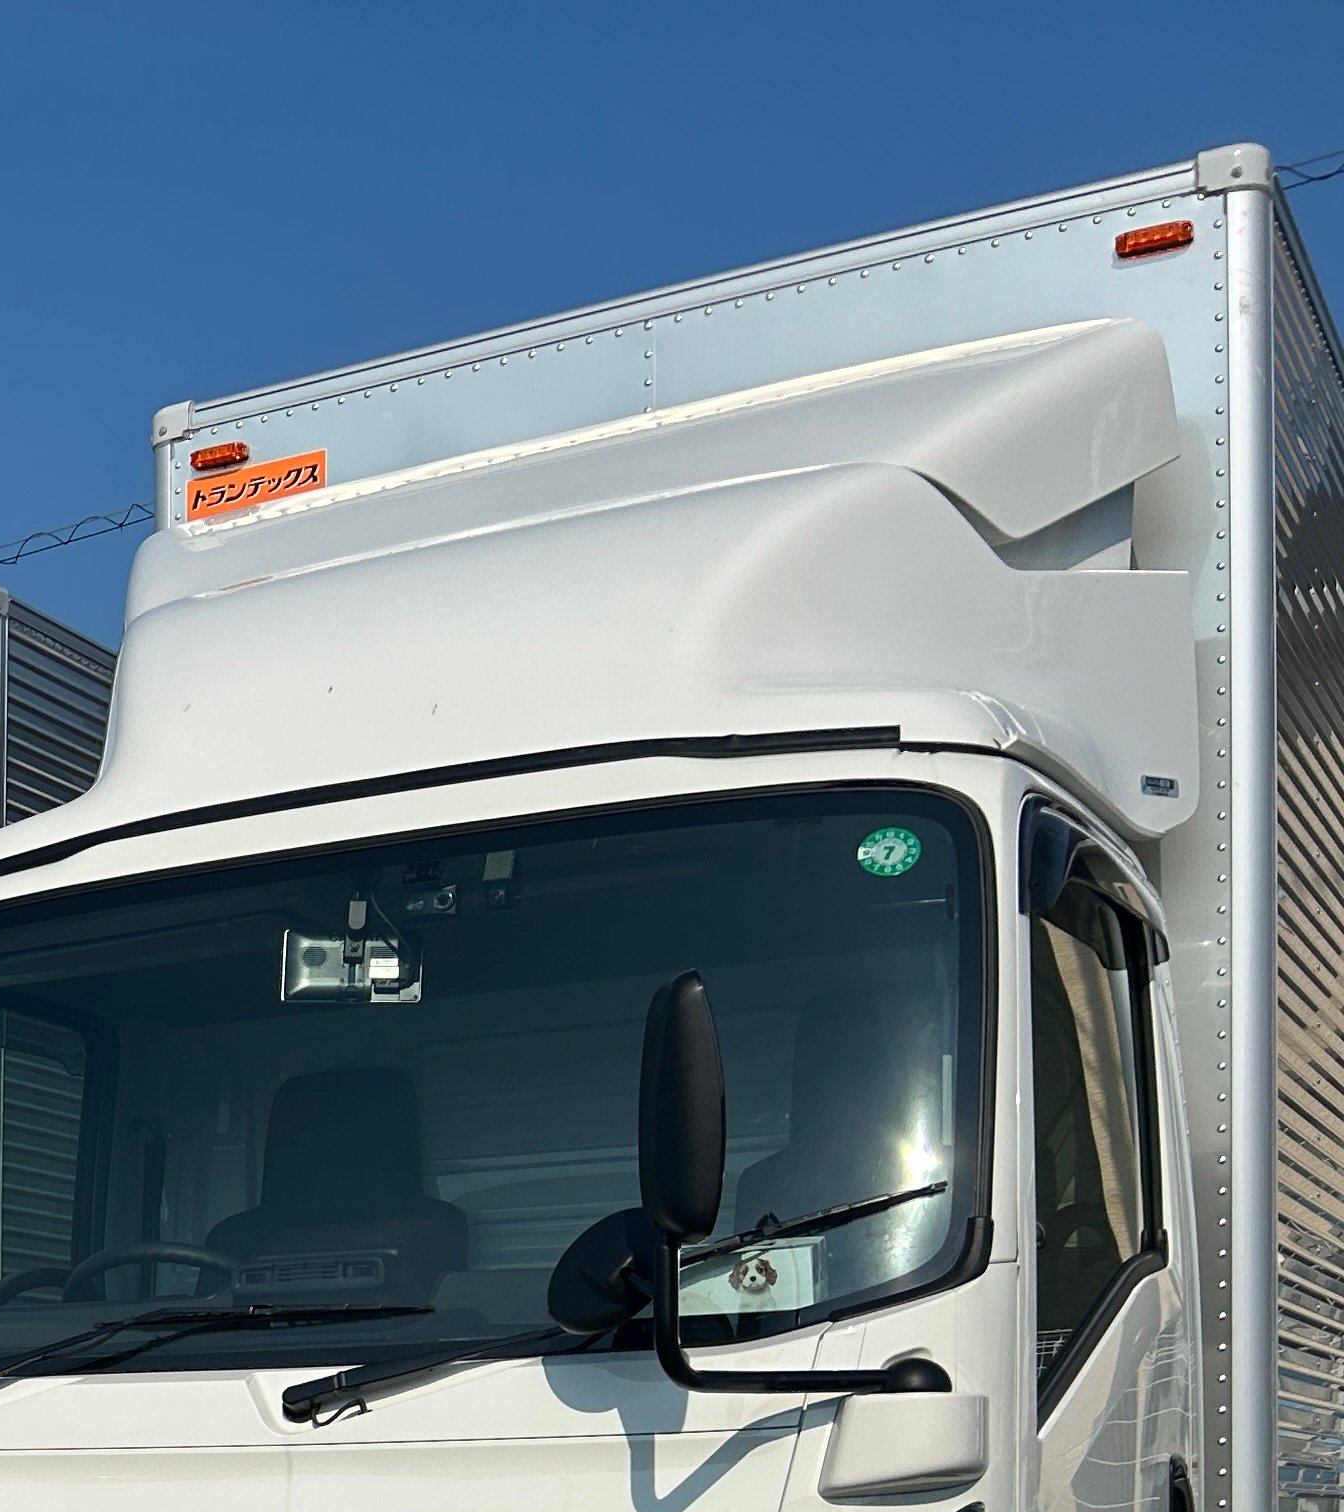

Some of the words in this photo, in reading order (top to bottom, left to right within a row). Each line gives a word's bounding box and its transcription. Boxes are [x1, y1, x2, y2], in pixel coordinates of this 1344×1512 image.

[192, 464, 319, 510] トランテックス
[883, 846, 896, 860] 7
